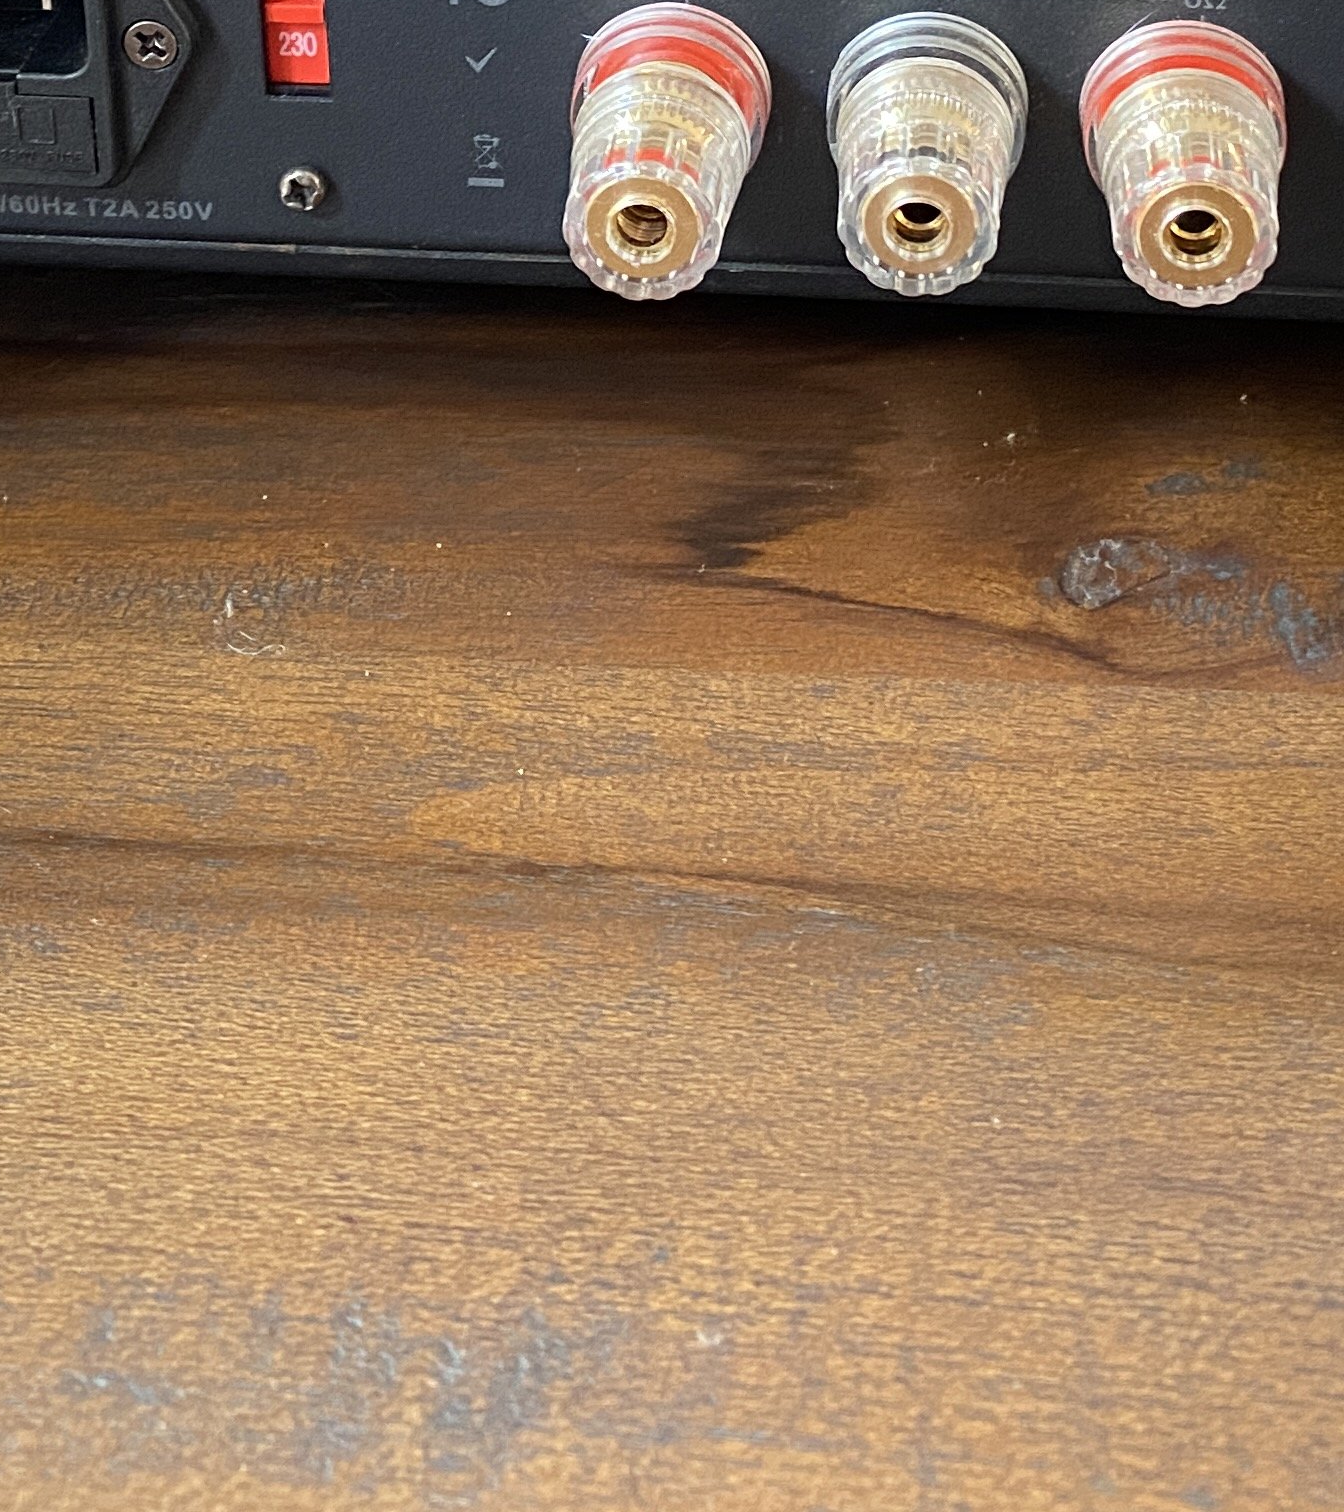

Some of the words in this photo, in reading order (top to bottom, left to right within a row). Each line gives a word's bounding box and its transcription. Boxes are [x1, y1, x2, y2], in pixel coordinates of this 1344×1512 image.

[278, 31, 318, 57] 230
[84, 195, 140, 220] T2A
[145, 200, 213, 222] 250V
